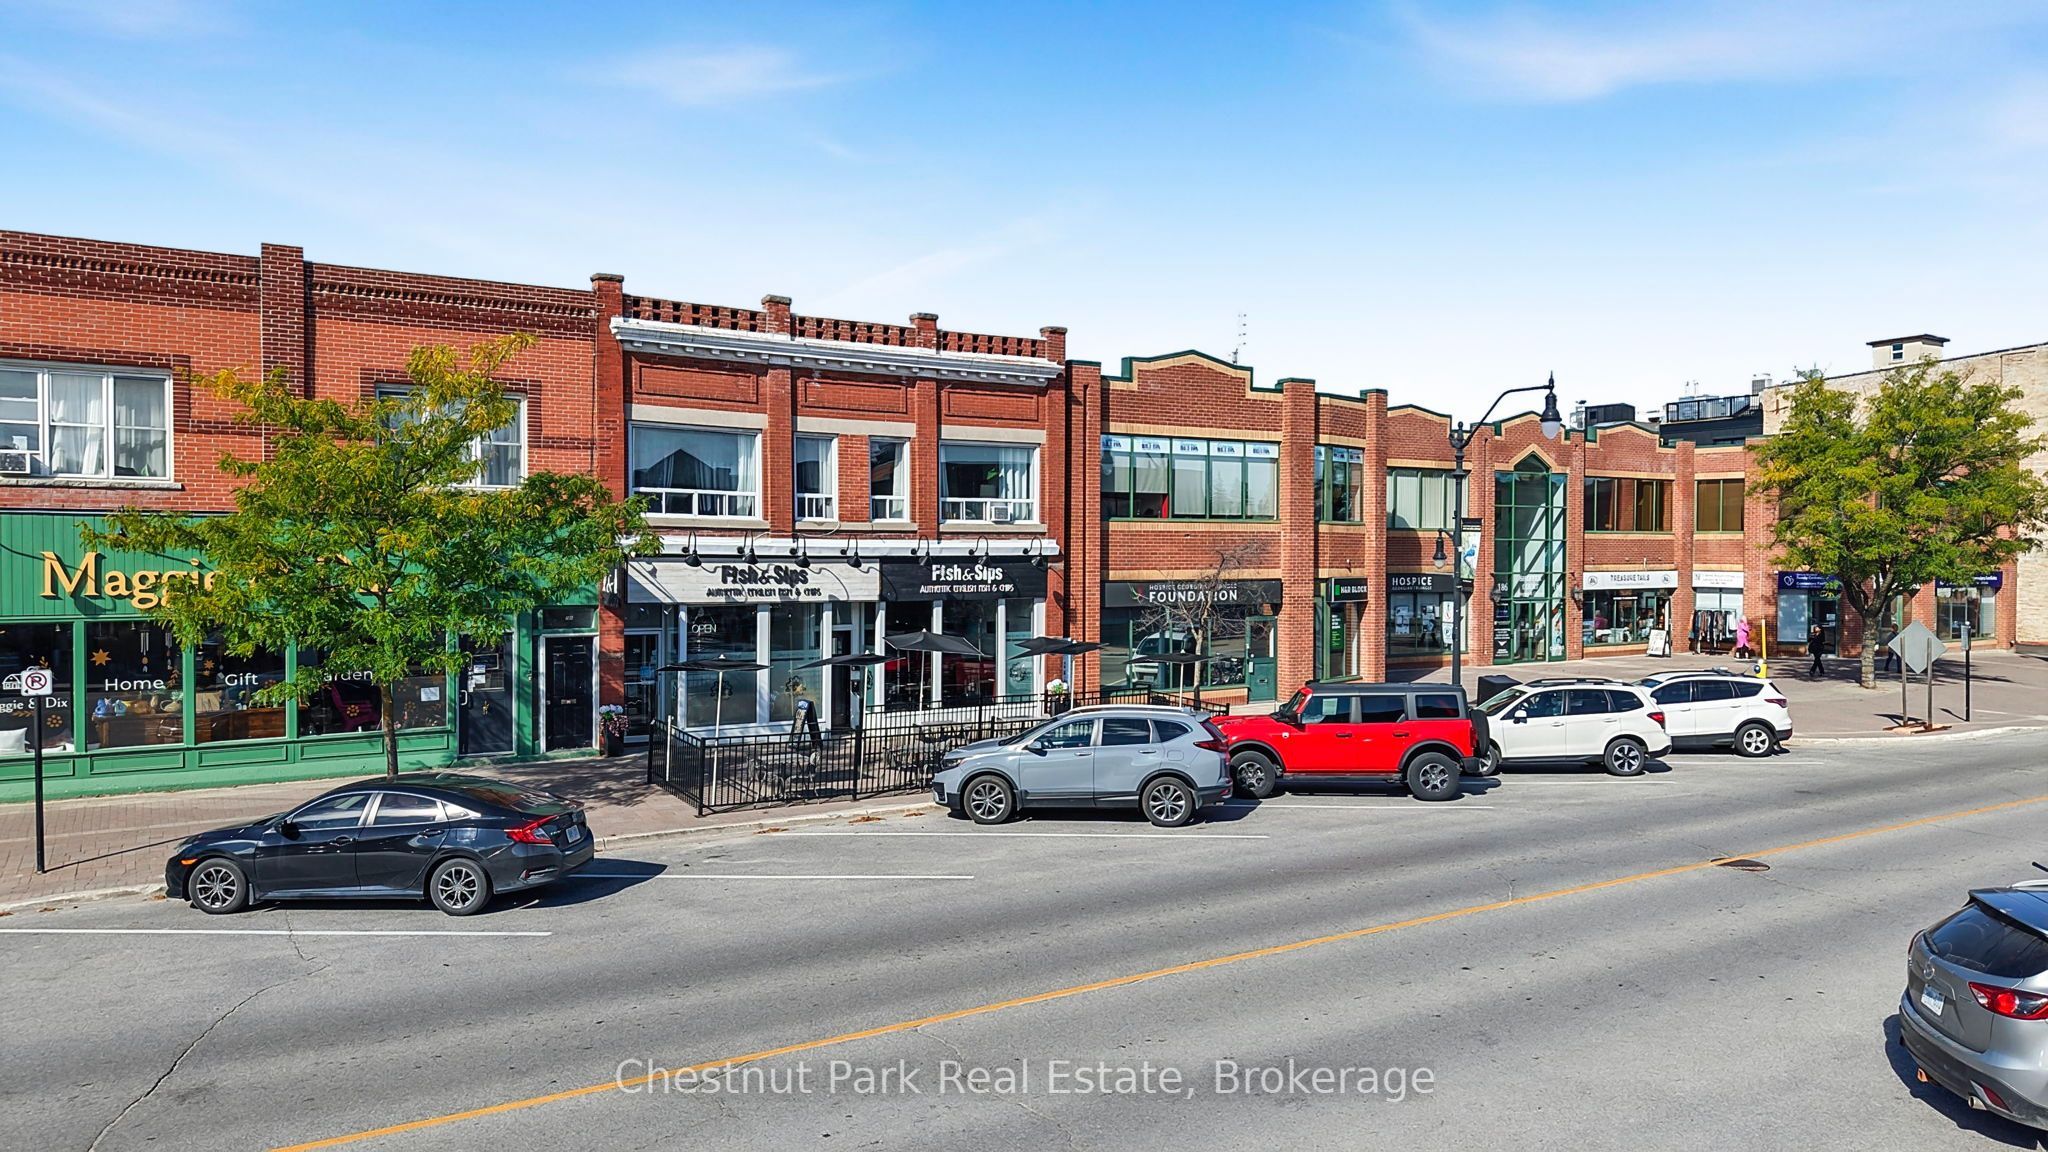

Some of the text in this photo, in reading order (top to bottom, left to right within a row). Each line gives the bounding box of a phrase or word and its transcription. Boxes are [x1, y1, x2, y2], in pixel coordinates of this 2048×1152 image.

[1392, 576, 1433, 586] HOSPICE
[1610, 574, 1636, 582] TREASURE
[1340, 584, 1367, 594] H&R BLOCK
[1497, 582, 1509, 592] 186
[691, 624, 717, 633] OPEN
[224, 672, 259, 686] Gift
[322, 669, 373, 682] arden
[104, 678, 164, 691] Home
[45, 697, 68, 709] Dix
